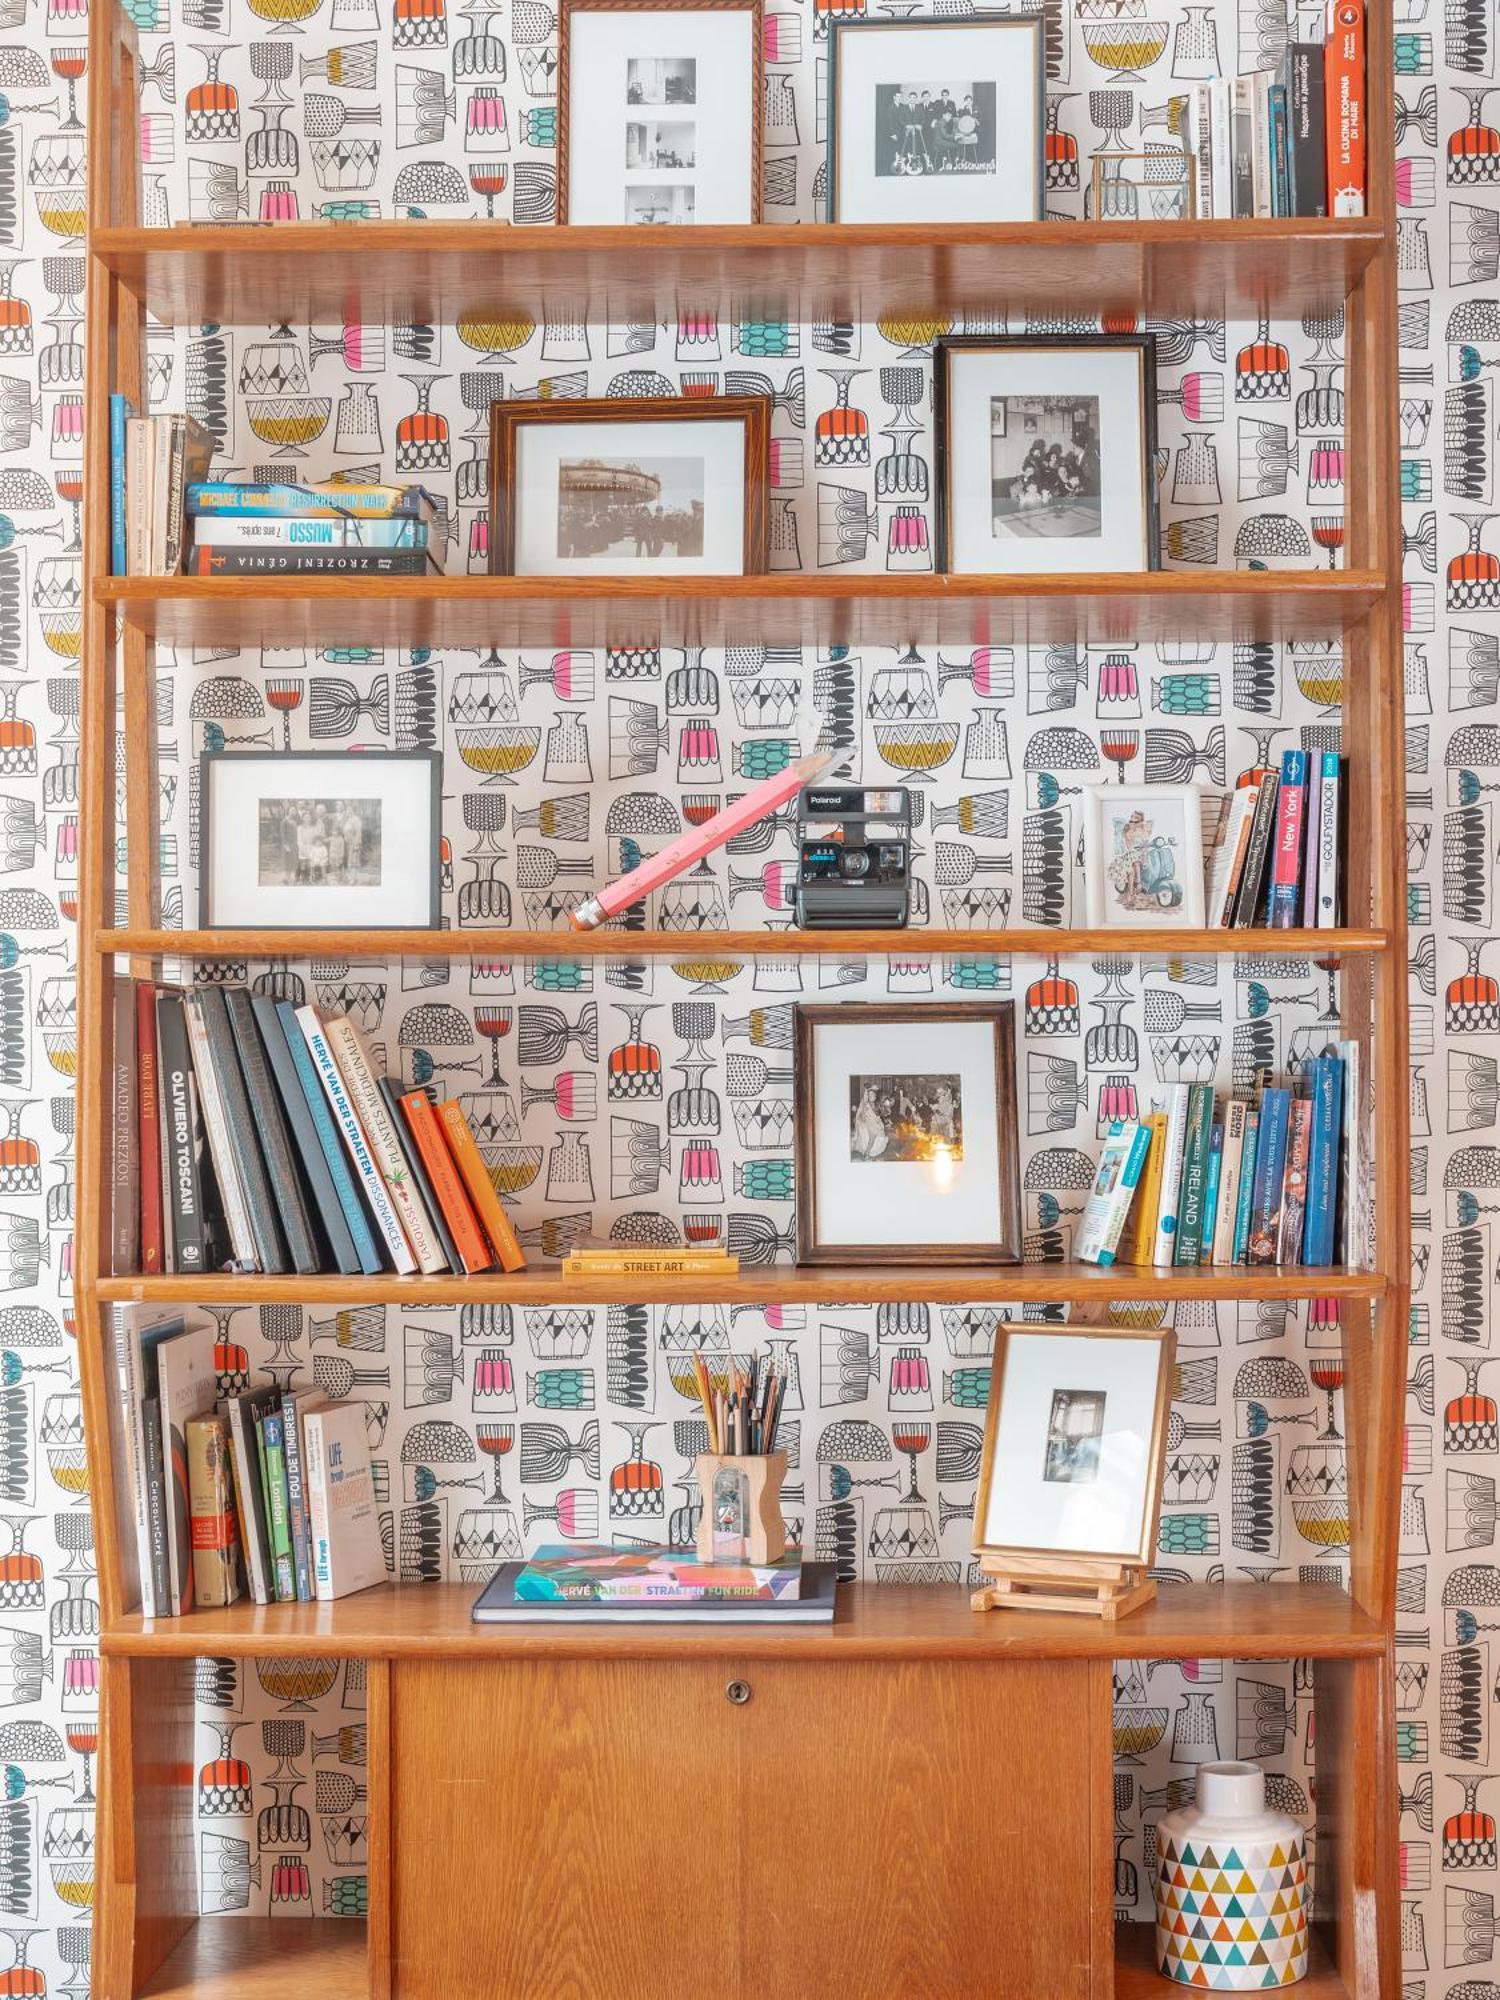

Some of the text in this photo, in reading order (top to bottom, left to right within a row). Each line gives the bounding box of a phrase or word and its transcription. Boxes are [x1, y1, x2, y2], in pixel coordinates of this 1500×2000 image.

[1300, 54, 1310, 94] декабре
[1301, 104, 1310, 138] Неделя
[1340, 76, 1350, 164] LA CUCINA ROMANA
[1350, 101, 1360, 139] DI MARE
[289, 522, 333, 543] MUSSO
[238, 557, 287, 568] GÉNIA
[297, 558, 369, 569] ZROZENÍ
[1284, 789, 1299, 819] York
[1281, 822, 1296, 852] New
[142, 1053, 154, 1119] LIVRE D'OR
[116, 1063, 130, 1187] AMADEO PREZIOSI
[372, 1109, 400, 1165] PLANTES
[1236, 1105, 1244, 1138] NORD
[171, 1070, 194, 1215] OLIVIERO TOSCANI
[326, 1070, 341, 1091] VAN
[335, 1091, 351, 1119] DER
[345, 1119, 374, 1175] STRAETEN
[366, 1173, 403, 1251] DISSONANCES
[1186, 1164, 1200, 1225] IRELAND
[403, 1204, 431, 1261] LAROUSSE
[623, 1262, 661, 1272] STREET
[663, 1261, 684, 1272] ART
[287, 1459, 299, 1475] DE
[271, 1480, 283, 1524] London
[288, 1477, 301, 1499] FOU
[646, 1585, 704, 1596] STRAETEN
[708, 1586, 732, 1596] FUN
[734, 1586, 760, 1596] RIDE
